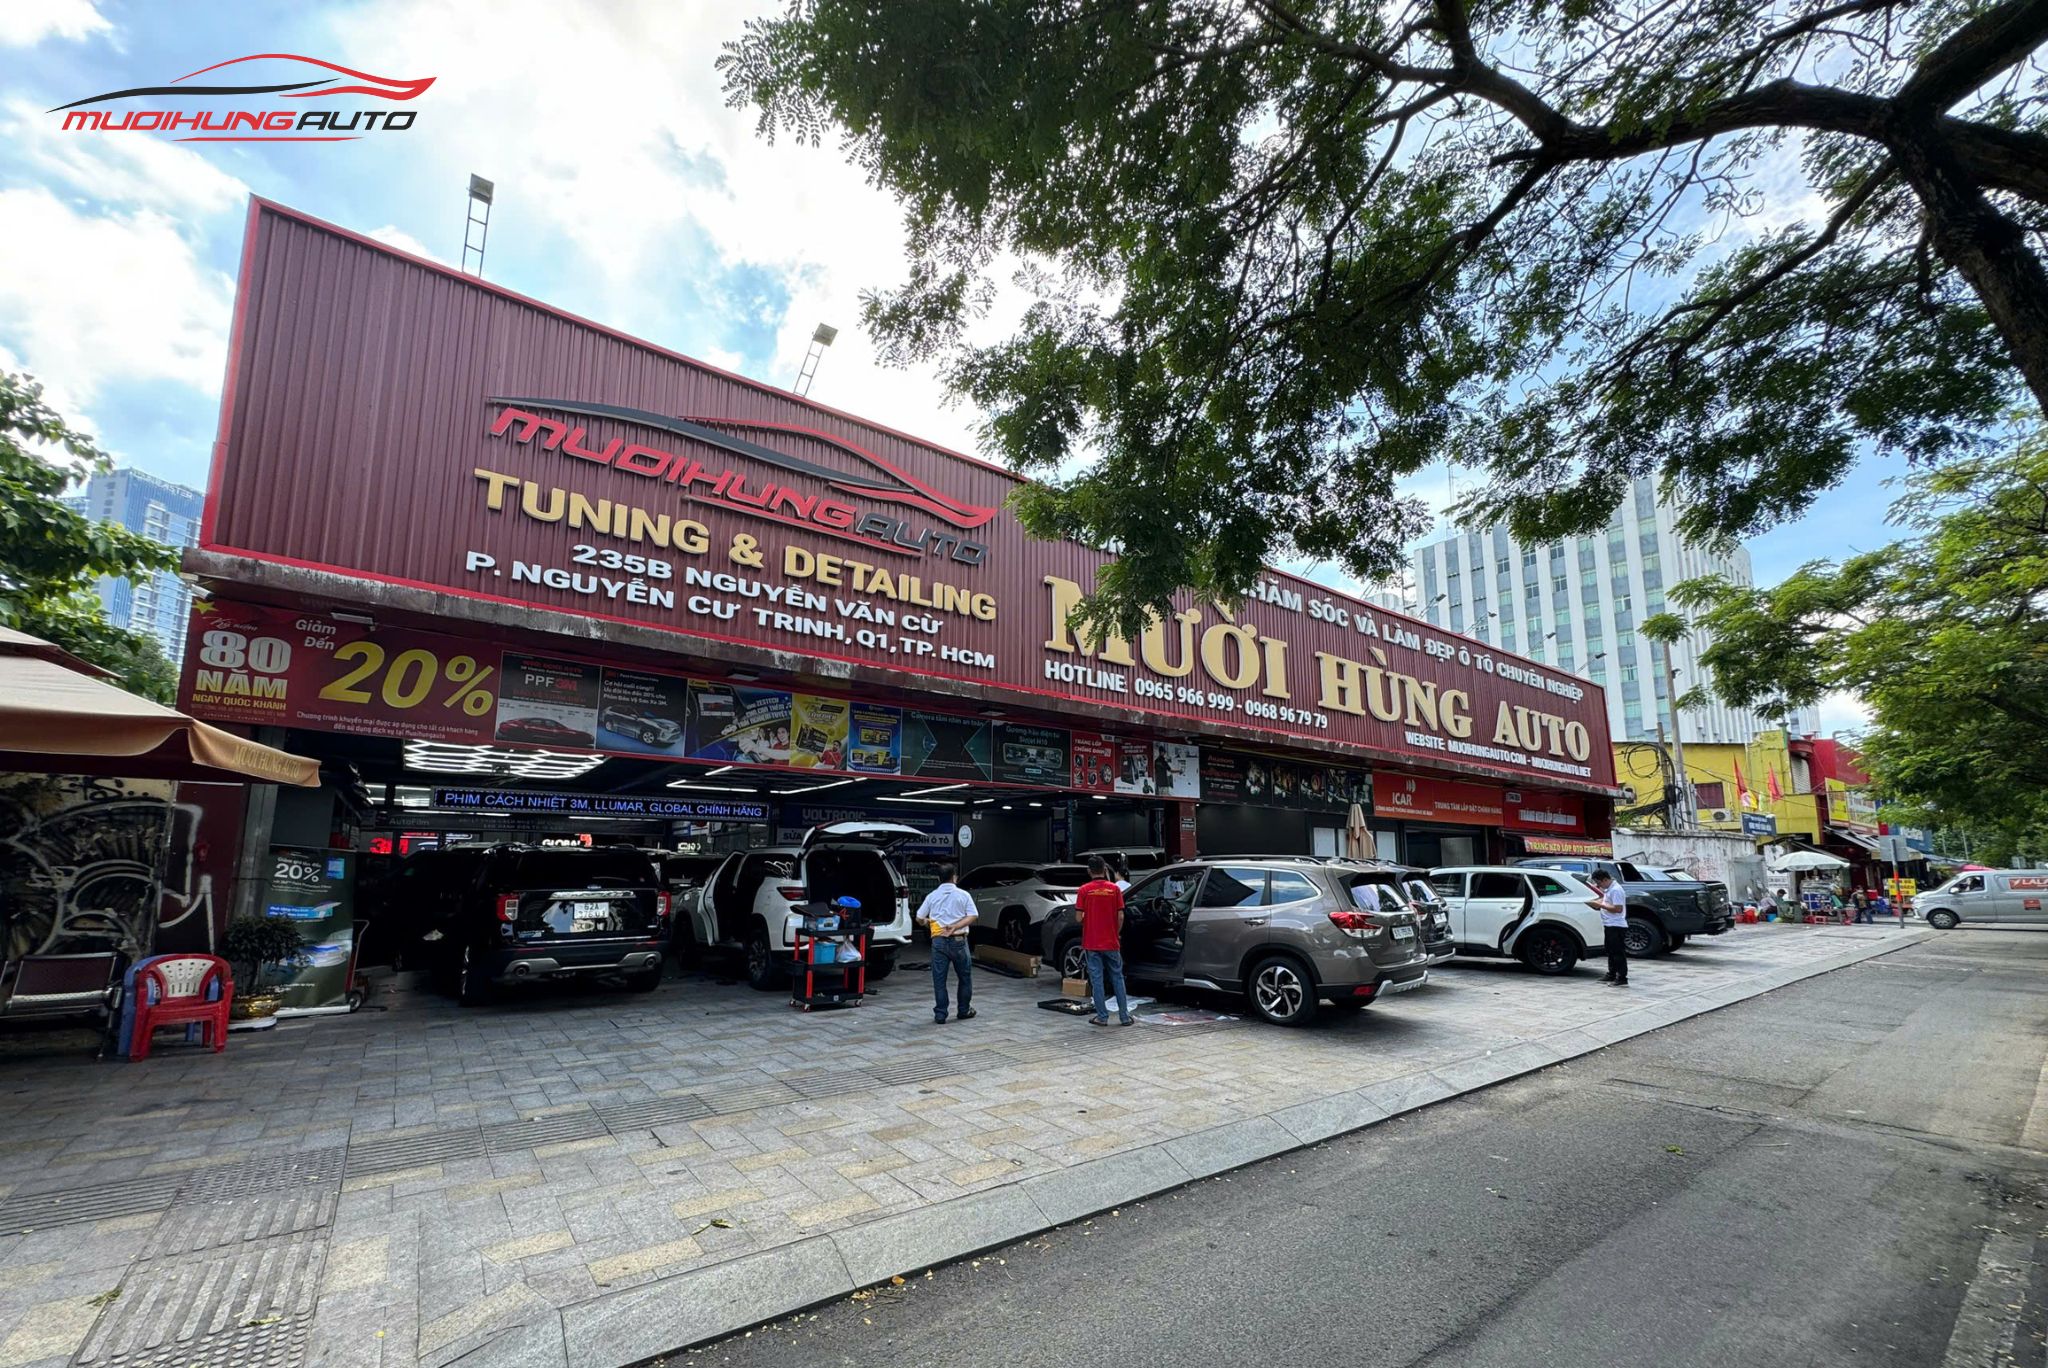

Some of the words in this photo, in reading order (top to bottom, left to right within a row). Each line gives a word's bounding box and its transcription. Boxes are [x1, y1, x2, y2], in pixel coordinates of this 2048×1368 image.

[474, 468, 709, 554] TUNING
[729, 533, 764, 569] &
[785, 545, 997, 621] DETAILING
[466, 551, 501, 576] P.
[512, 560, 675, 609] NGUYỄN
[688, 596, 741, 620] CƯ
[572, 544, 672, 579] 235B
[685, 567, 826, 613] NGUYỄN
[834, 598, 895, 627] VĂN
[901, 613, 944, 635] CỪ
[296, 619, 337, 635] Giảm
[304, 635, 335, 650] Đến
[200, 630, 292, 674] 80
[1308, 597, 1349, 627] SÓC
[1353, 611, 1379, 638] VÀ
[1382, 623, 1421, 650] LÀM
[1425, 637, 1454, 663] ĐẸP
[1459, 648, 1471, 667] Ô
[1474, 653, 1494, 673] TÔ
[1496, 663, 1545, 691] CHUYÊN
[1546, 677, 1584, 703] NGHIỆP
[195, 668, 288, 700] NĂM
[319, 641, 494, 717] 20%
[524, 673, 555, 687] PPF
[1135, 678, 1173, 701] 0965
[1176, 686, 1204, 707] 966
[1208, 692, 1234, 712] 999
[1245, 700, 1277, 721] 0968
[1280, 706, 1294, 723] 96
[1314, 713, 1328, 729] 79
[1315, 646, 1473, 738] HÙNG
[1493, 700, 1591, 762] AUTO
[445, 793, 481, 804] PHIM
[649, 802, 694, 814] GLOBAL
[1392, 792, 1412, 806] ICAR
[274, 863, 320, 882] 20%
